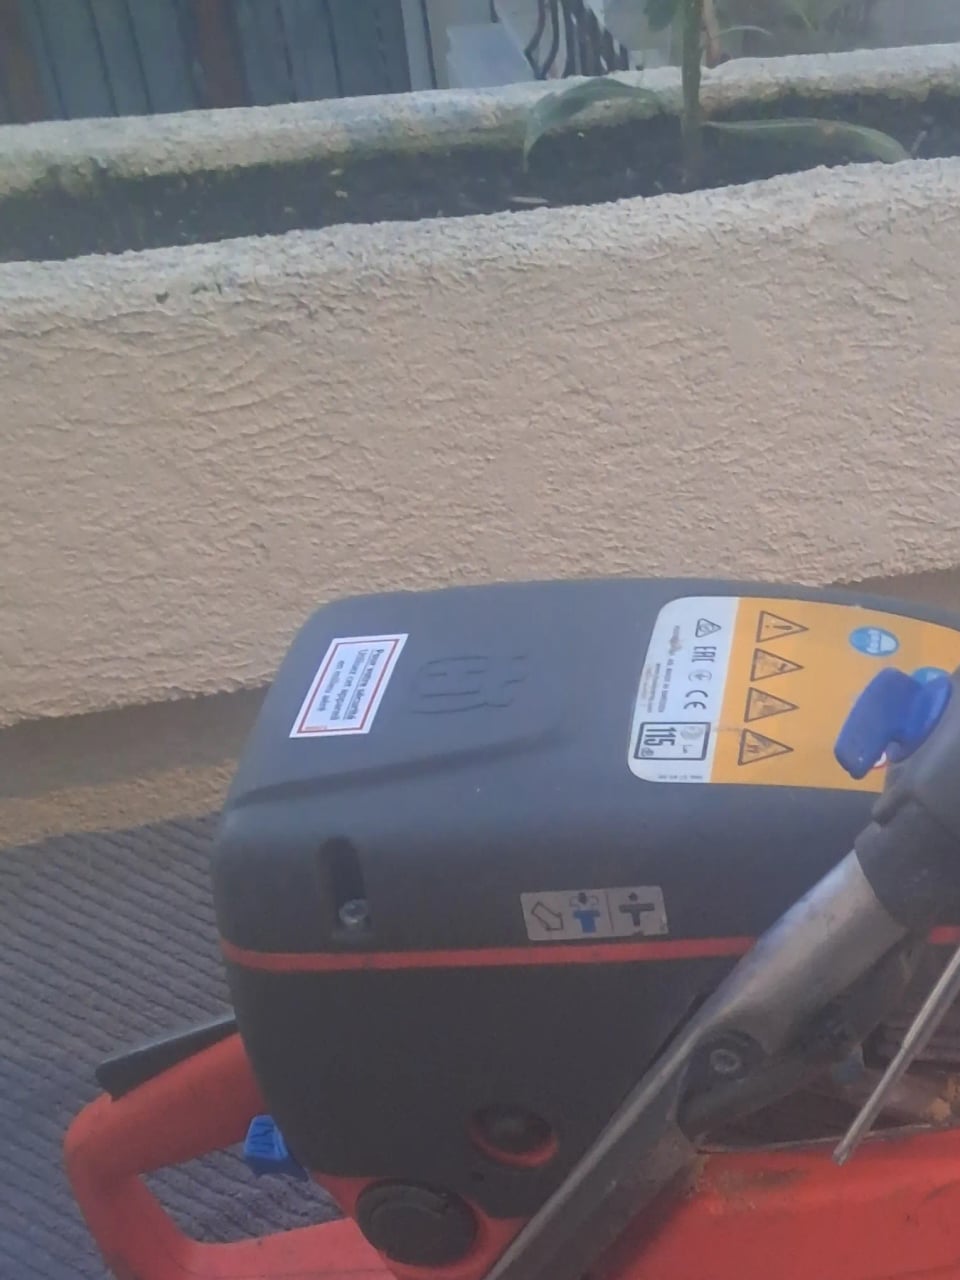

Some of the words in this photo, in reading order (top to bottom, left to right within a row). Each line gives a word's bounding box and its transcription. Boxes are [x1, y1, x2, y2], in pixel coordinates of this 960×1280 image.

[370, 649, 384, 666] Pour
[359, 669, 376, 687] votre
[683, 690, 708, 710] CE
[644, 727, 677, 746] 115
